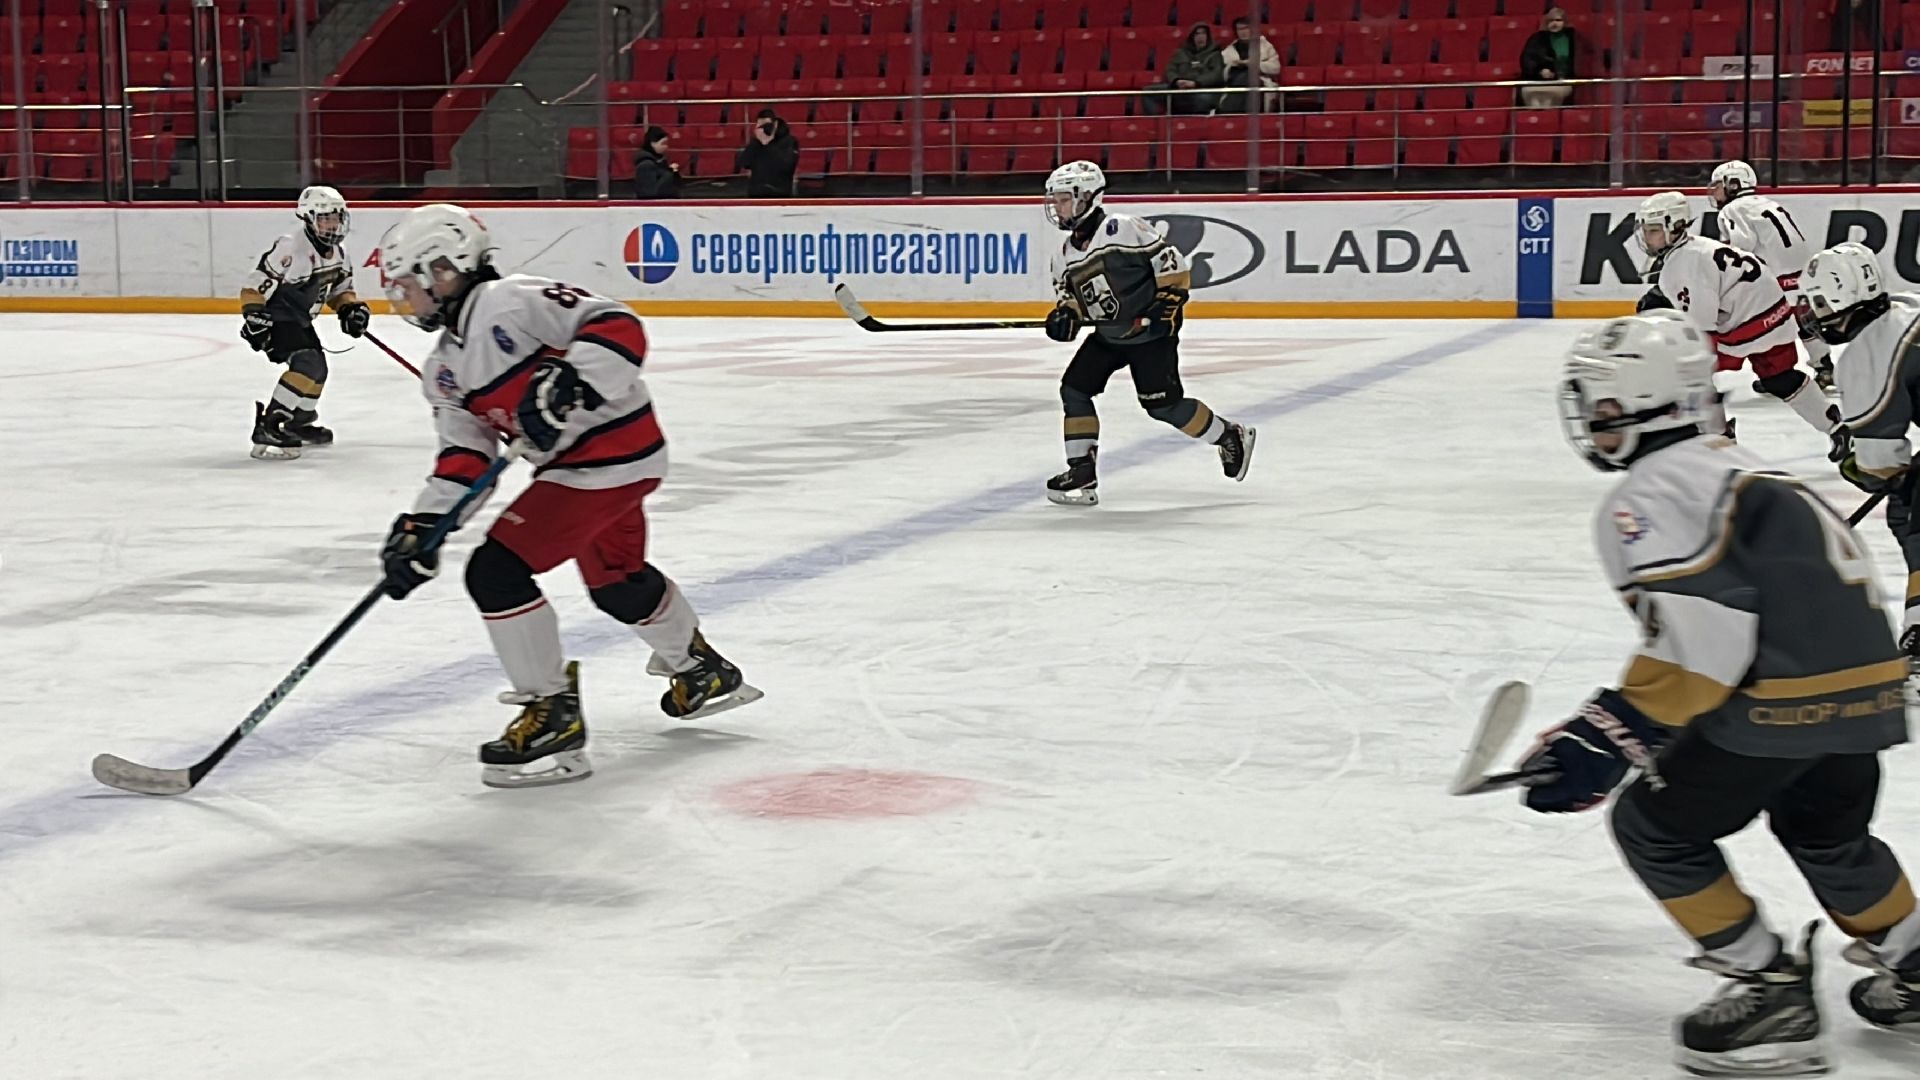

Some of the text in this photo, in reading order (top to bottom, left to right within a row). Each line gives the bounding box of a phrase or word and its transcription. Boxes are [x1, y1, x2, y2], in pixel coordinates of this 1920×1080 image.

[1806, 57, 1875, 73] FONET
[5, 240, 78, 261] ГАЗПРОМ
[691, 223, 1028, 284] севернефтегазпром
[1159, 249, 1178, 273] 23
[1284, 229, 1471, 274] LADA
